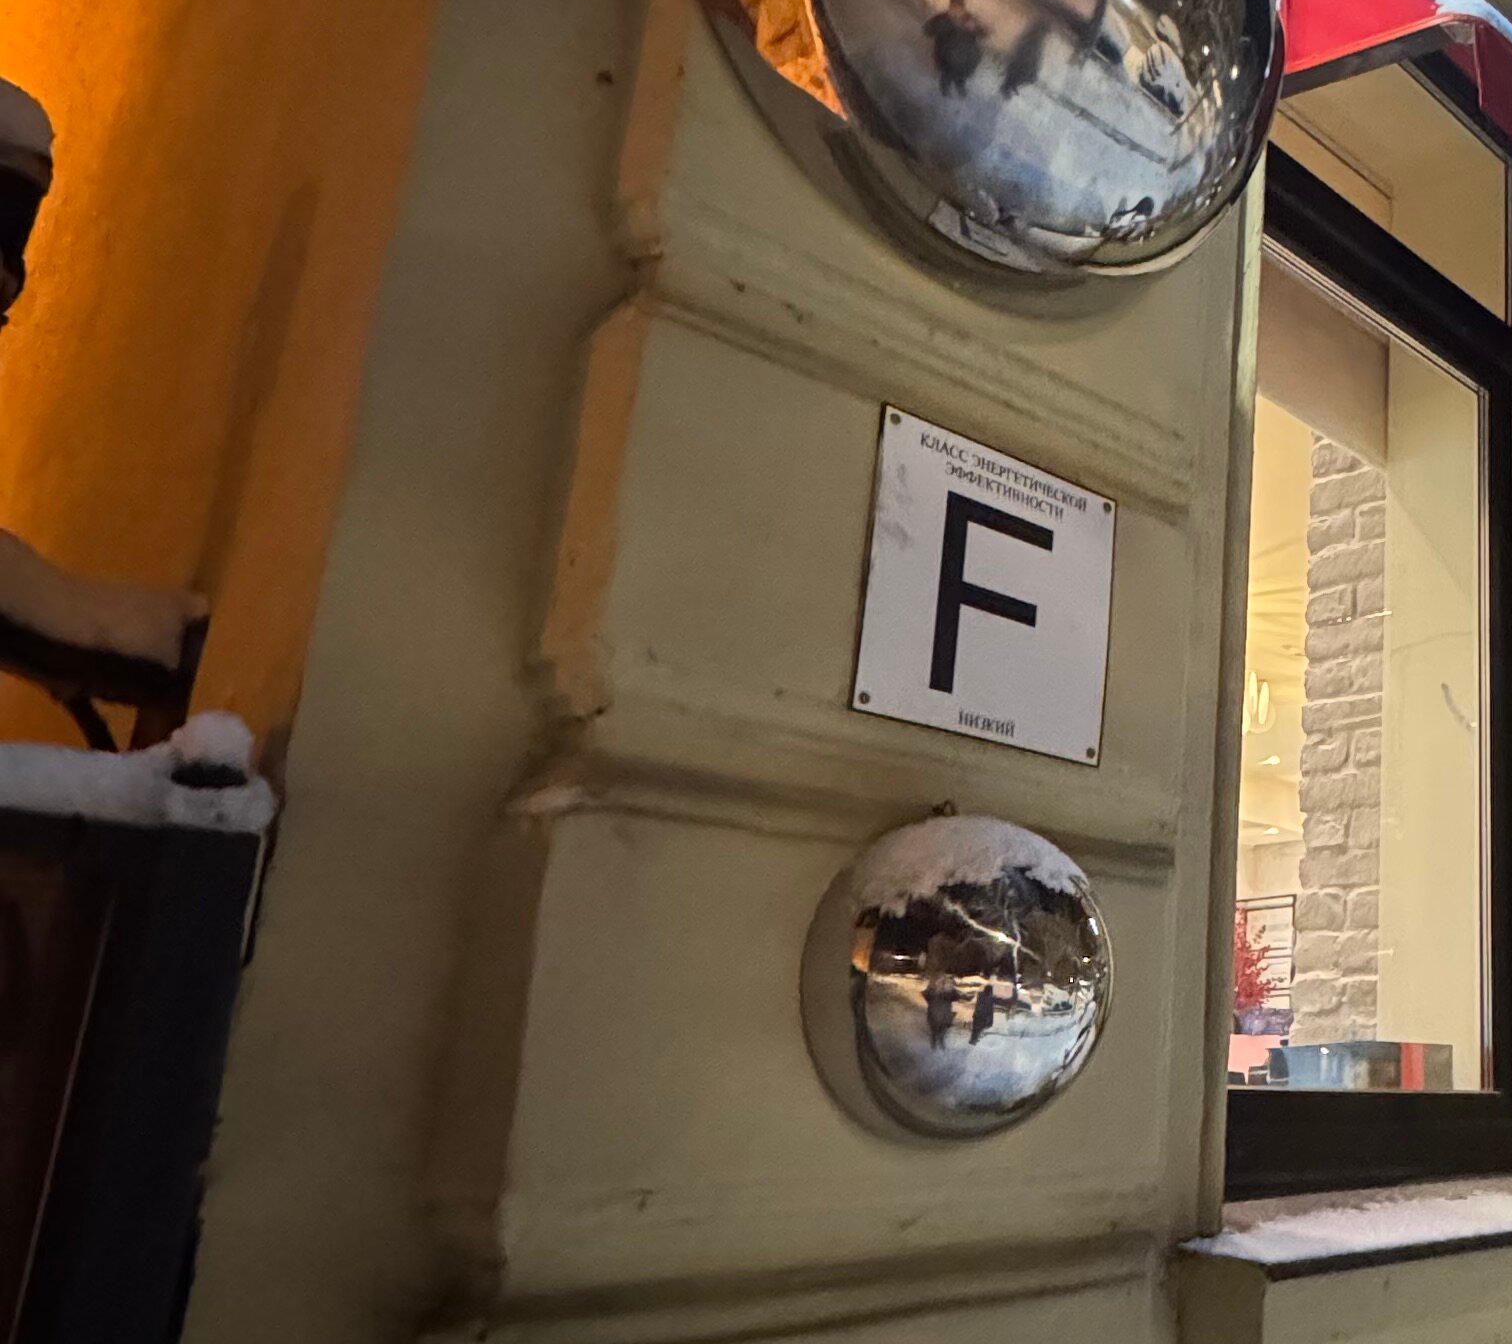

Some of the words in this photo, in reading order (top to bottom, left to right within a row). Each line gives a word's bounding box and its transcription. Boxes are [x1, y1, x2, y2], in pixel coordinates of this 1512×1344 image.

[919, 432, 968, 462] КЛАСС
[971, 453, 1088, 512] ЭНЕРГЕТИЧЕСКОЙ
[945, 461, 1064, 521] ЭФФЕКТИВНОСТИ
[929, 490, 1054, 694] F
[959, 710, 1015, 738] НИЗКИЙ
